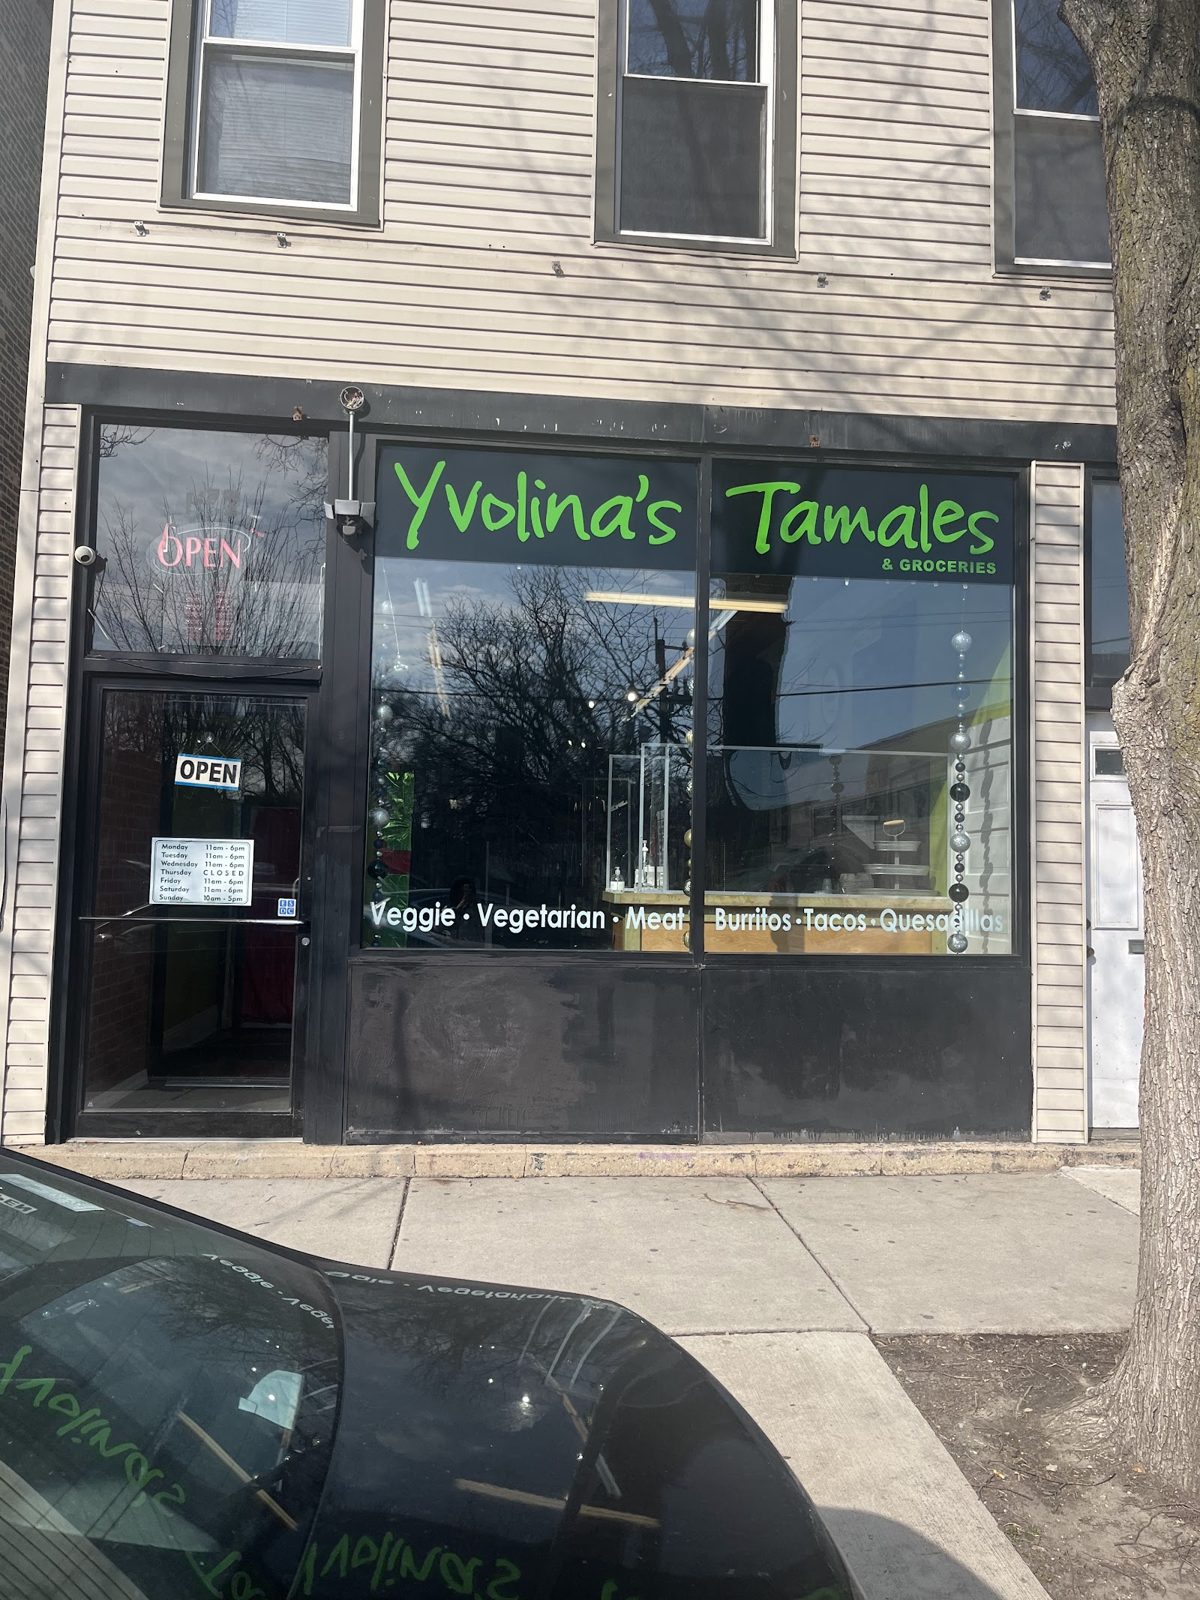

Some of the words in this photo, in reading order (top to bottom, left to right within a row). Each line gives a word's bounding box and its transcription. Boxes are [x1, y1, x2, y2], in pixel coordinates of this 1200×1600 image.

[394, 459, 683, 551] Yvolina's
[725, 481, 1001, 556] Tamales
[157, 533, 241, 569] OPEN
[882, 558, 894, 571] &
[899, 559, 997, 576] GROCERIES
[180, 759, 238, 784] OPEN
[160, 860, 198, 868] Wednesday
[369, 901, 456, 932] Veggie
[477, 902, 605, 933] Vegetarian
[625, 906, 684, 931] Meat
[715, 907, 792, 932] Burritos
[803, 908, 867, 932] Tacos
[880, 908, 1004, 933] Quesadillas
